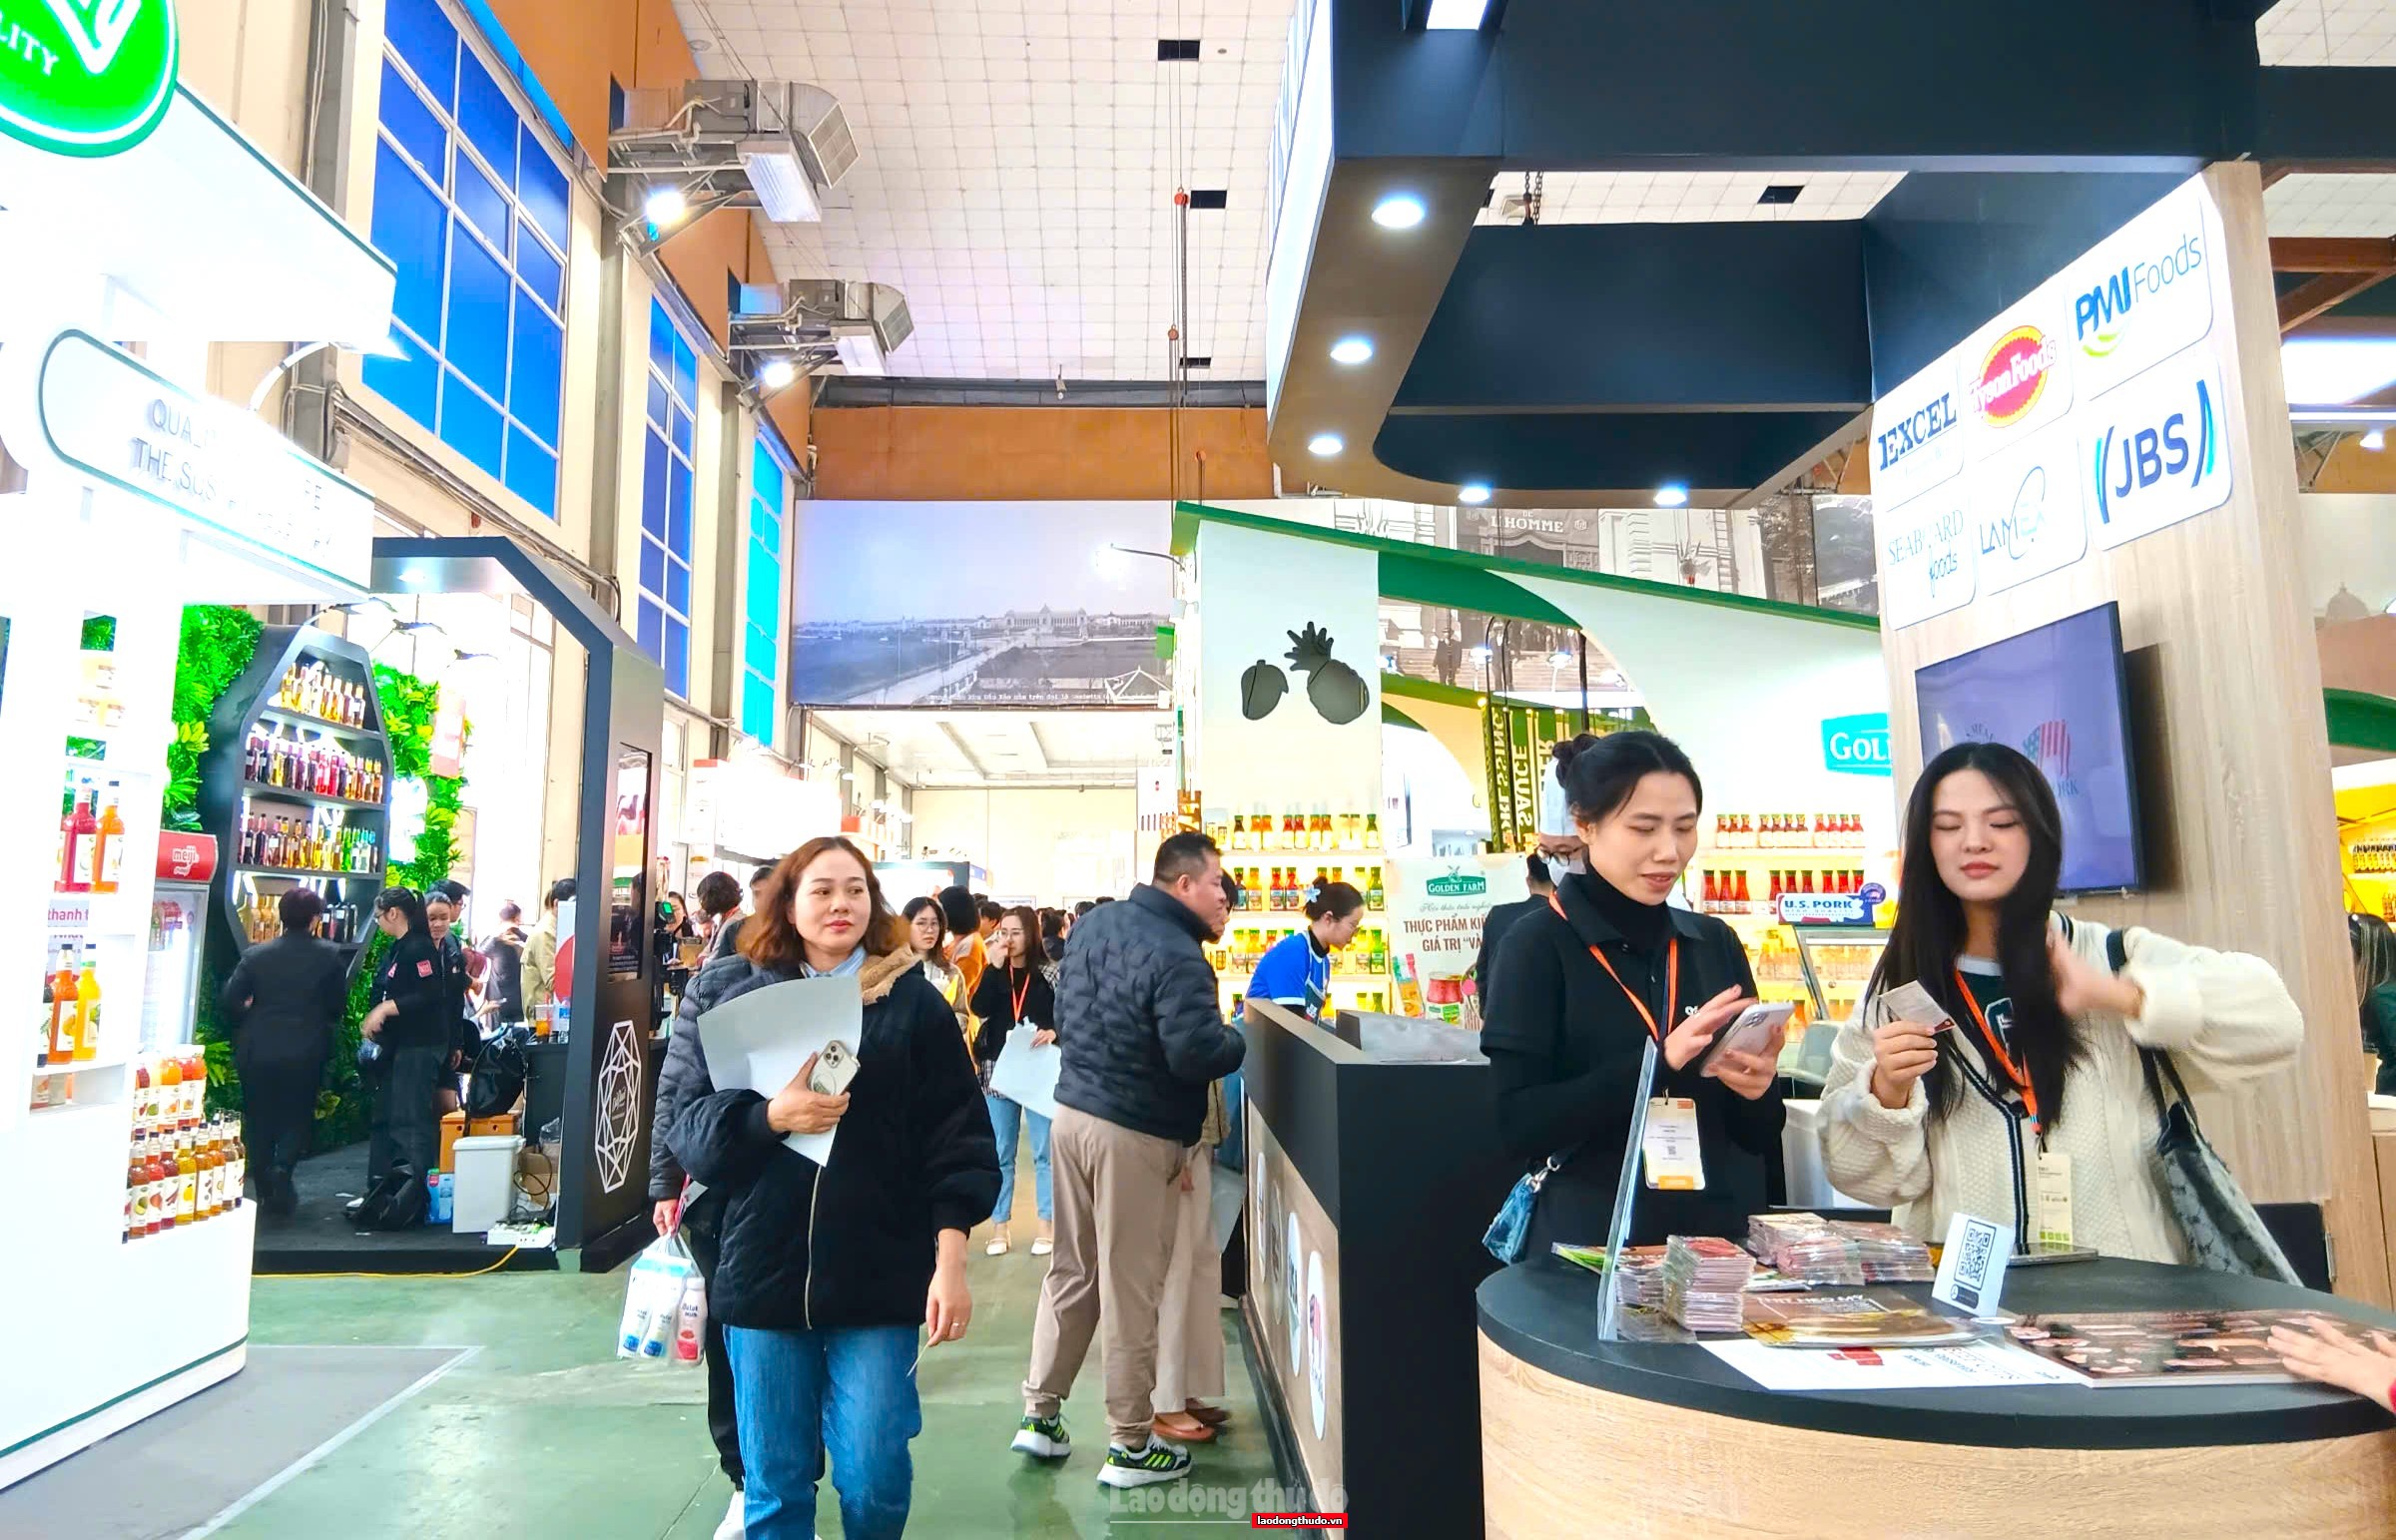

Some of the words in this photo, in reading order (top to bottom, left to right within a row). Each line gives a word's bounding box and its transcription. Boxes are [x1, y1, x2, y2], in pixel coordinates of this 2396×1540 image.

[2076, 266, 2131, 340] PMI
[2133, 234, 2201, 302] Foods
[1878, 392, 1957, 471] EXCEL
[1428, 883, 1460, 893] GOLDEN
[1463, 881, 1485, 891] FARM
[1404, 918, 1433, 936] THỰC
[1435, 913, 1468, 931] PHẨM
[1423, 934, 1441, 952] GIÁ
[1443, 937, 1461, 954] TRỊ
